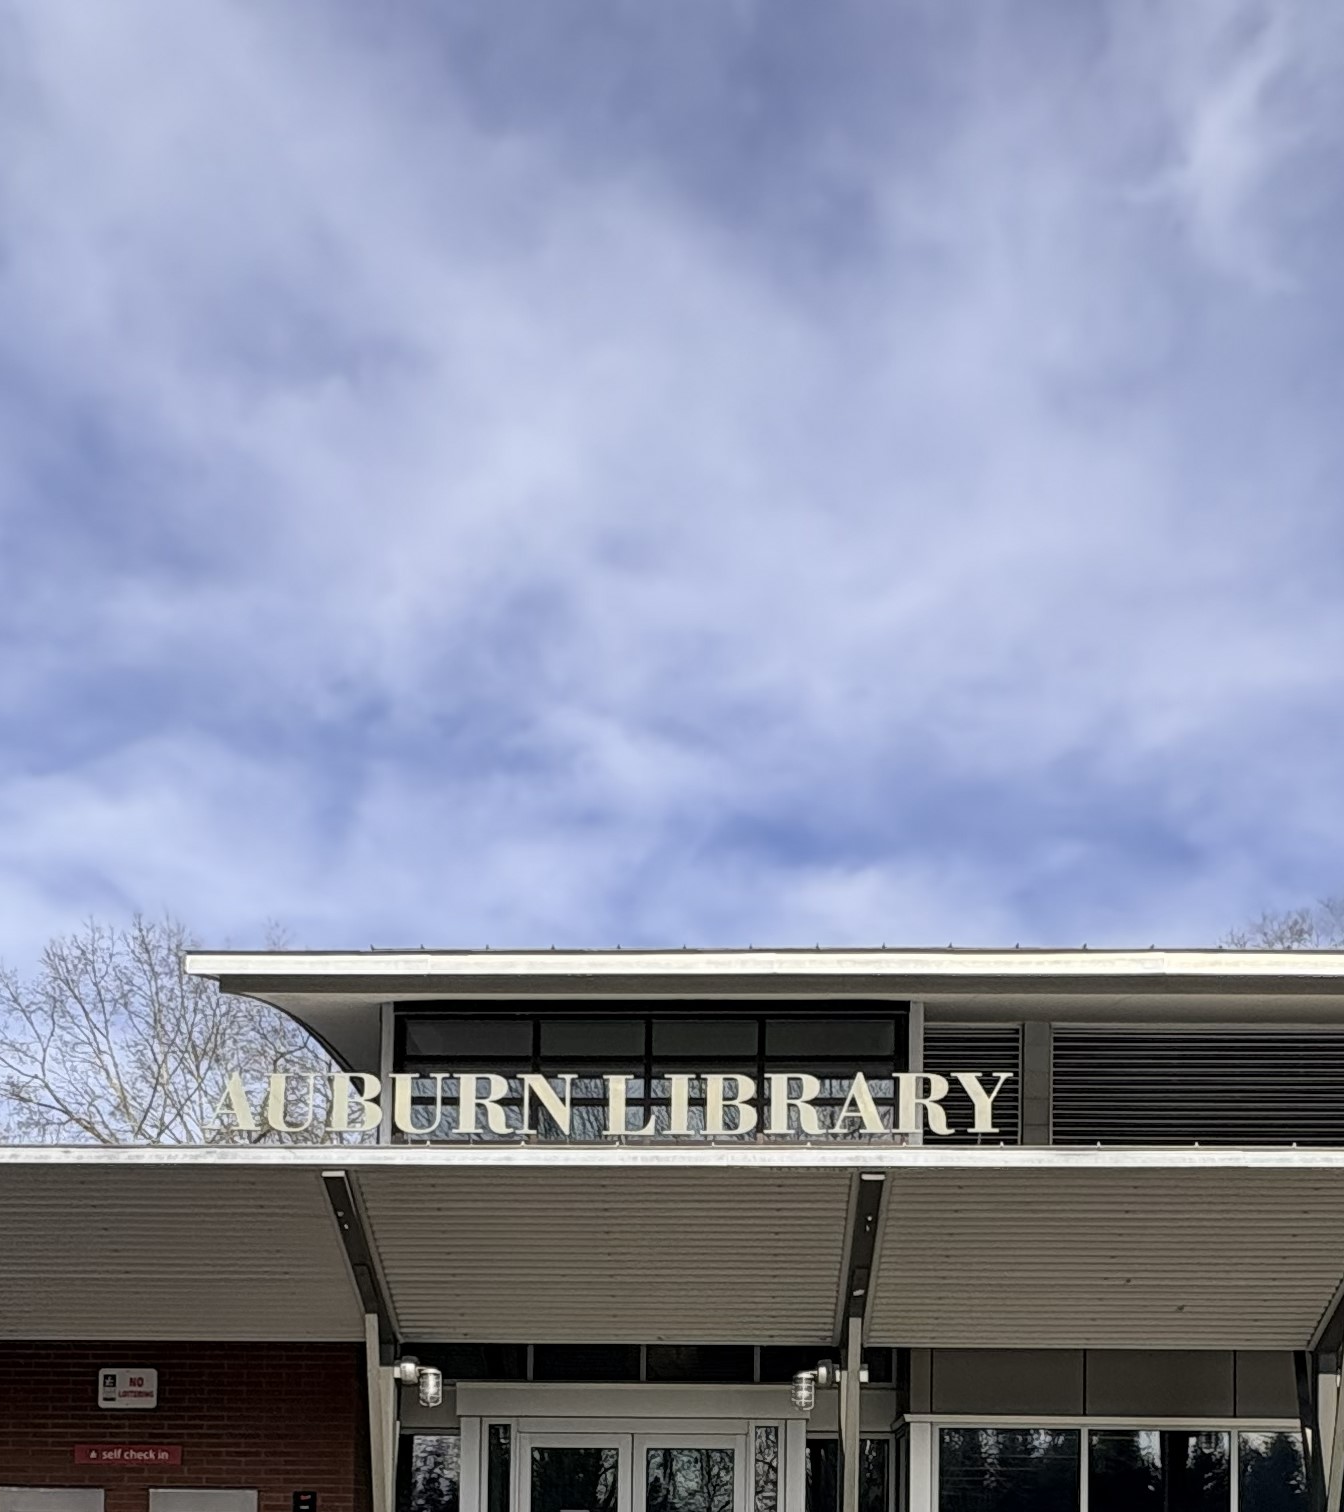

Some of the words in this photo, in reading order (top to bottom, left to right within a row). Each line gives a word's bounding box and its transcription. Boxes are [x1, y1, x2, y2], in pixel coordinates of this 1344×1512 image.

[201, 1072, 578, 1135] AUBURN
[602, 1072, 1014, 1135] LIBRARY
[129, 1377, 144, 1387] NO
[102, 1449, 122, 1459] self
[124, 1449, 155, 1459] check
[157, 1449, 169, 1459] in
